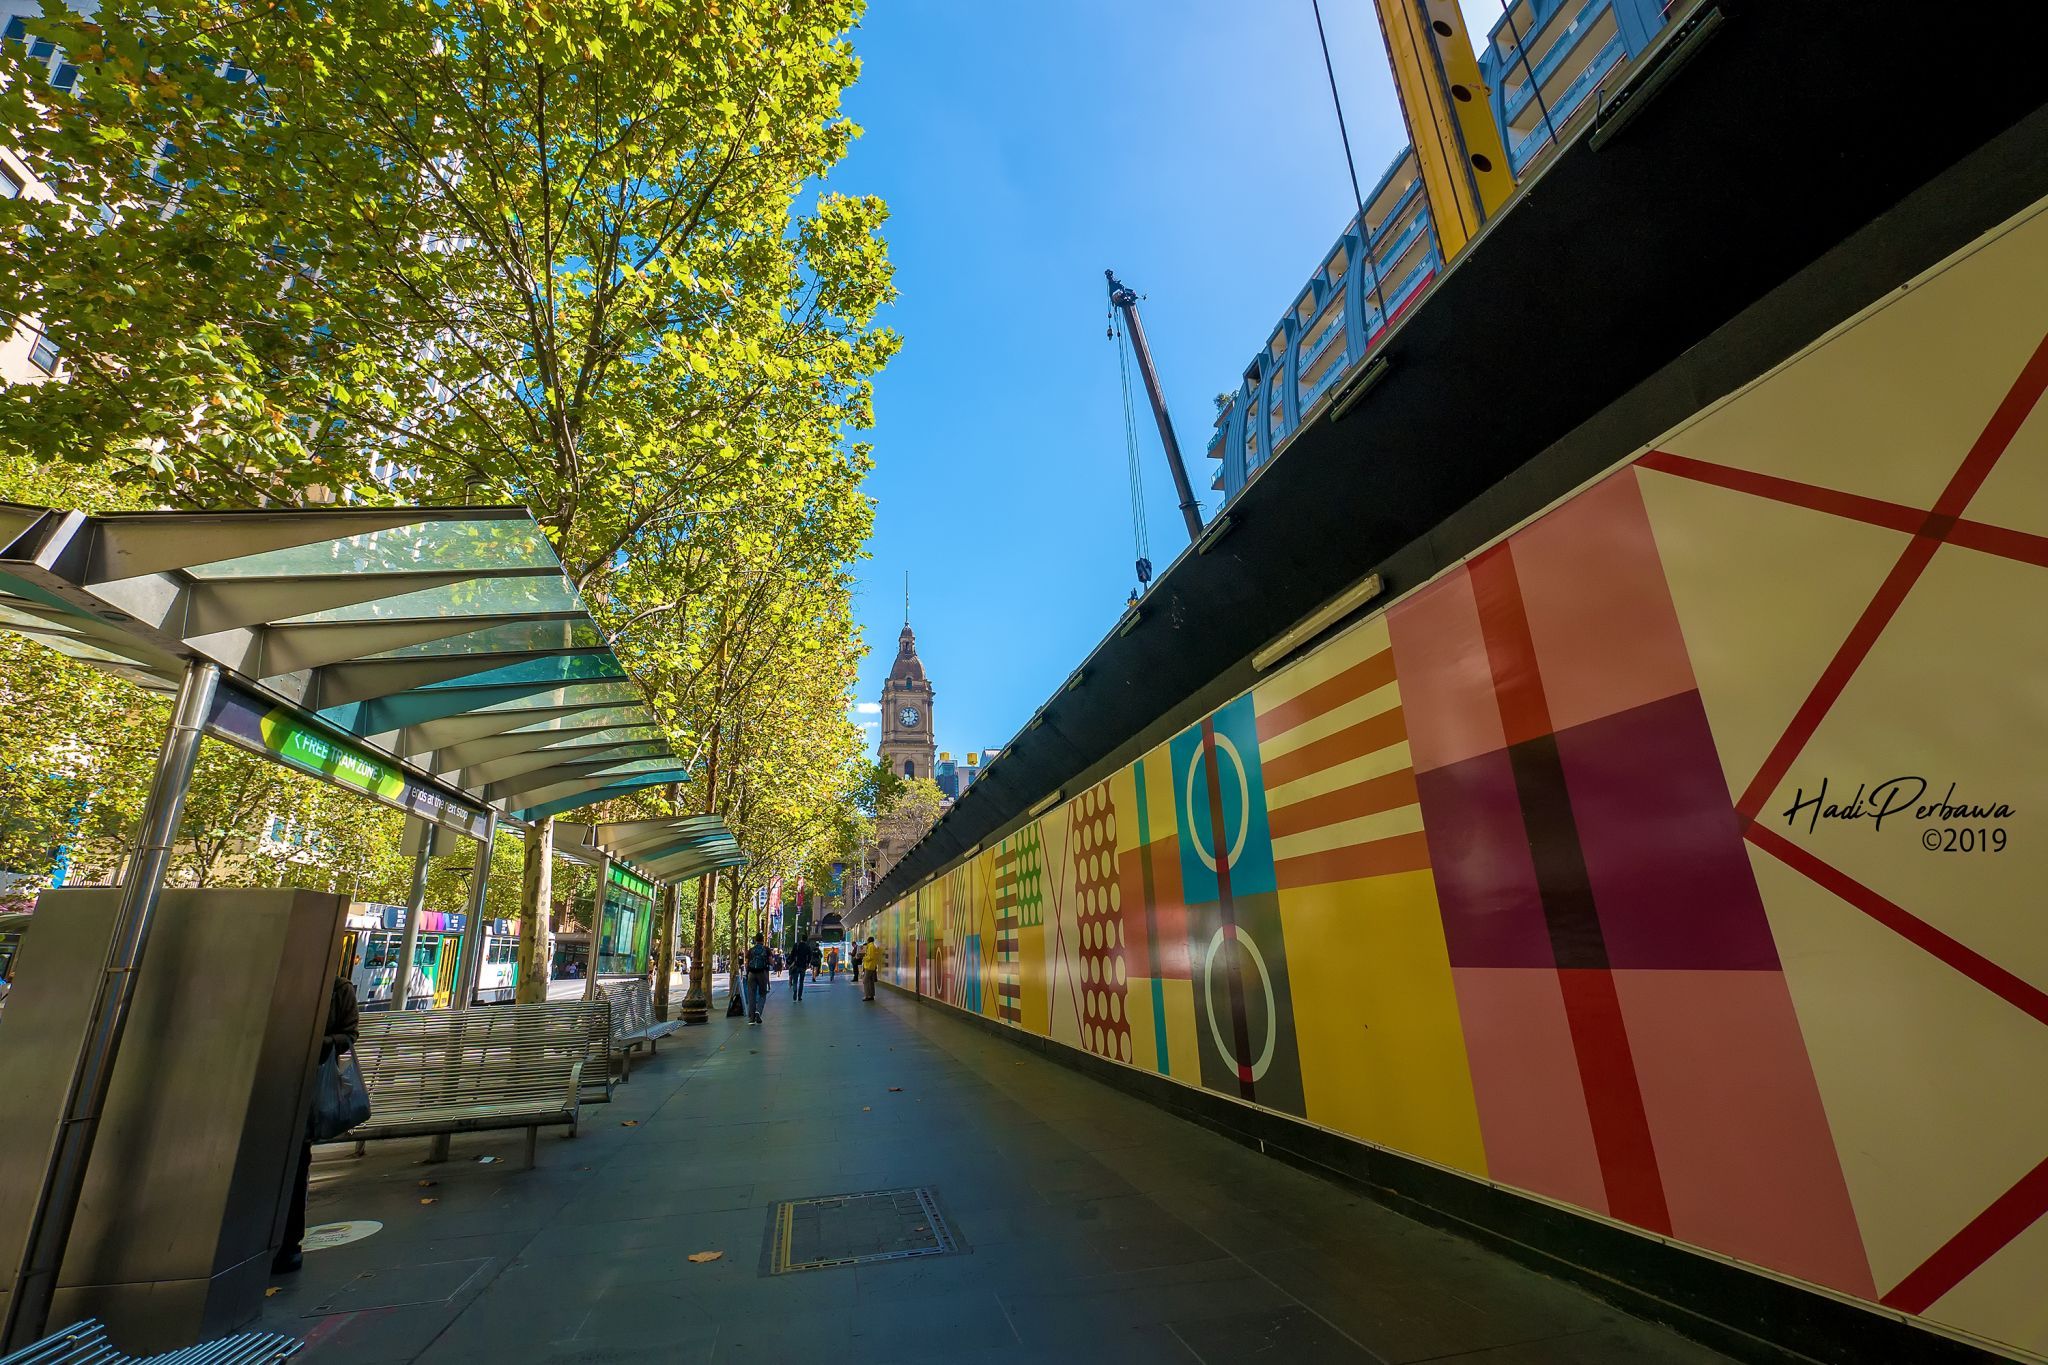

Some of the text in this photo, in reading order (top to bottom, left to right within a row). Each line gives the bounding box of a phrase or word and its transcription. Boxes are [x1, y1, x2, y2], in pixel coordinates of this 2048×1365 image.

[303, 734, 378, 780] FREE TRAM ZONE
[412, 787, 427, 802] ends
[434, 795, 444, 810] the
[445, 801, 456, 815] next
[456, 806, 468, 822] stop
